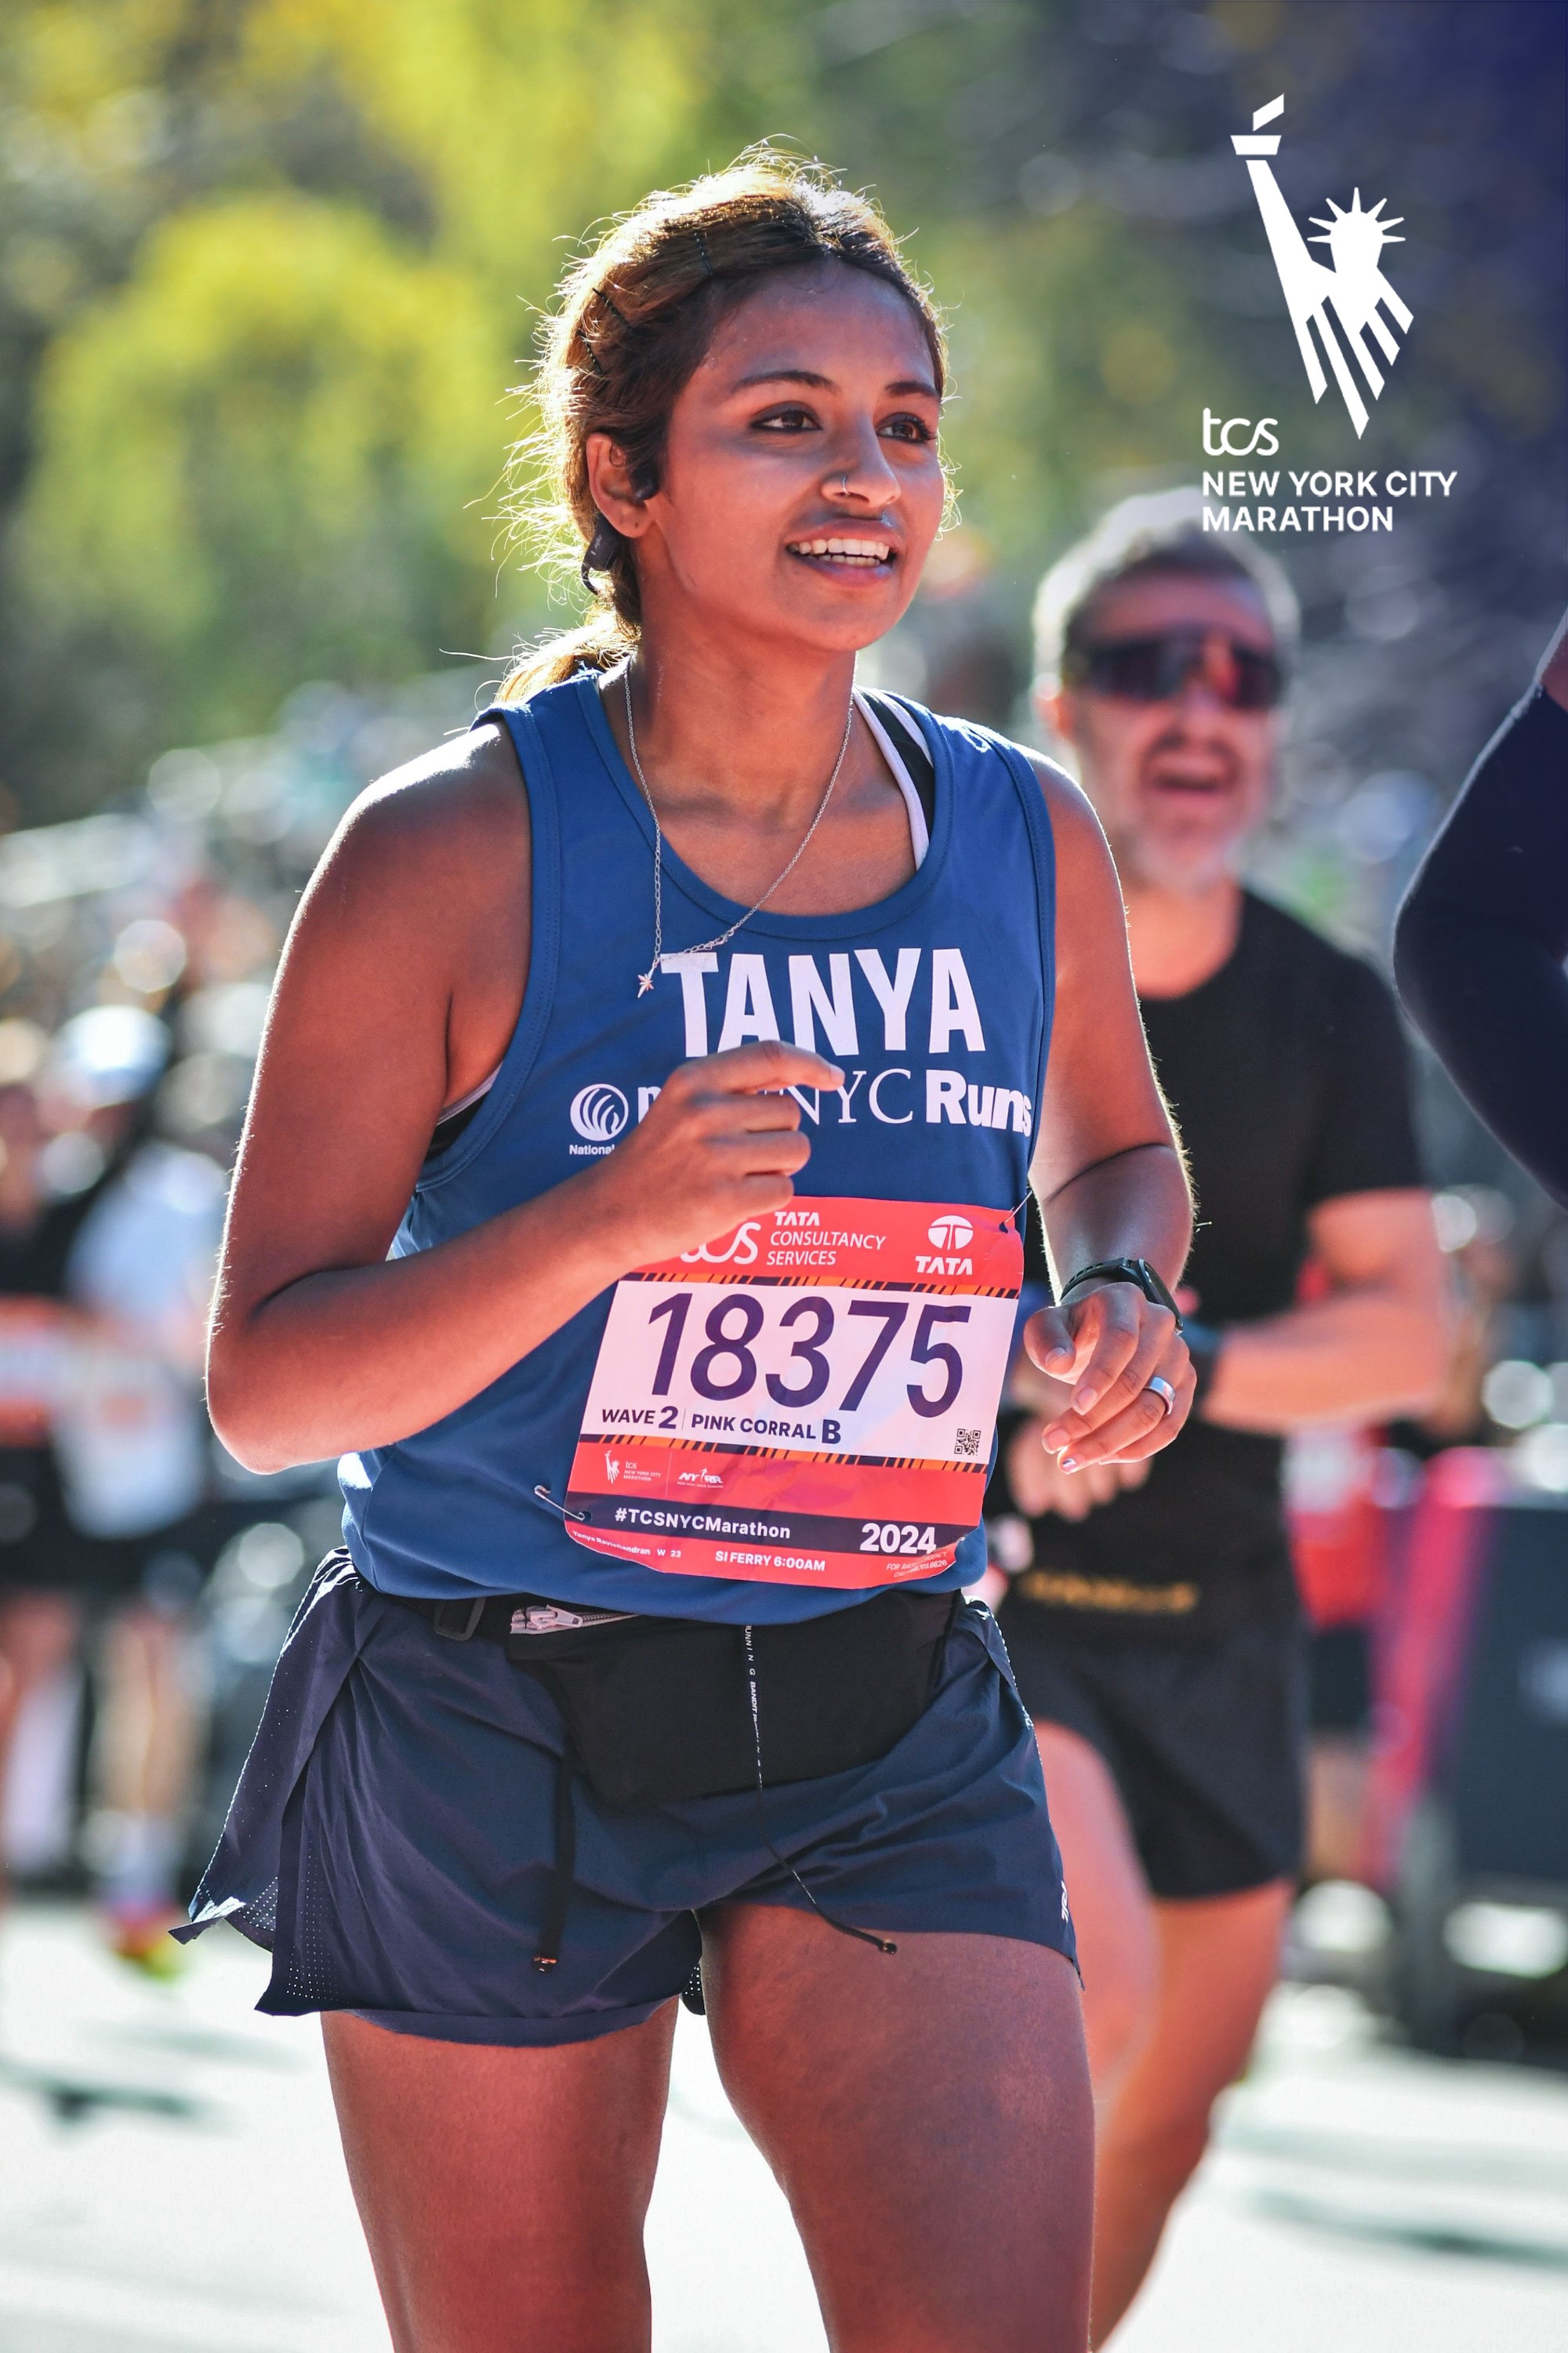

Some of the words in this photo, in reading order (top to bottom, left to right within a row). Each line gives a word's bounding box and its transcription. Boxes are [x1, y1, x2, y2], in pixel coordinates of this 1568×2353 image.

[659, 947, 986, 1058] TANYA
[774, 1211, 821, 1227] TATA
[770, 1229, 887, 1251] CONSULTANCY
[766, 1249, 837, 1267] SERVICES
[915, 1255, 974, 1276] TATA
[647, 1292, 972, 1418] 18375
[601, 1408, 656, 1425] WAVE
[658, 1405, 679, 1429] 2
[691, 1413, 737, 1432] PINK
[739, 1417, 817, 1440] CORRAL
[821, 1418, 842, 1445] B
[615, 1507, 791, 1539] #TCSNYCMarathon
[572, 1531, 596, 1542] Tanya
[657, 1548, 666, 1556] W
[670, 1549, 682, 1558] 23
[859, 1522, 938, 1555] 2024
[715, 1550, 728, 1563] SI
[729, 1552, 772, 1567] FERRY
[774, 1556, 826, 1571] 6:00AM
